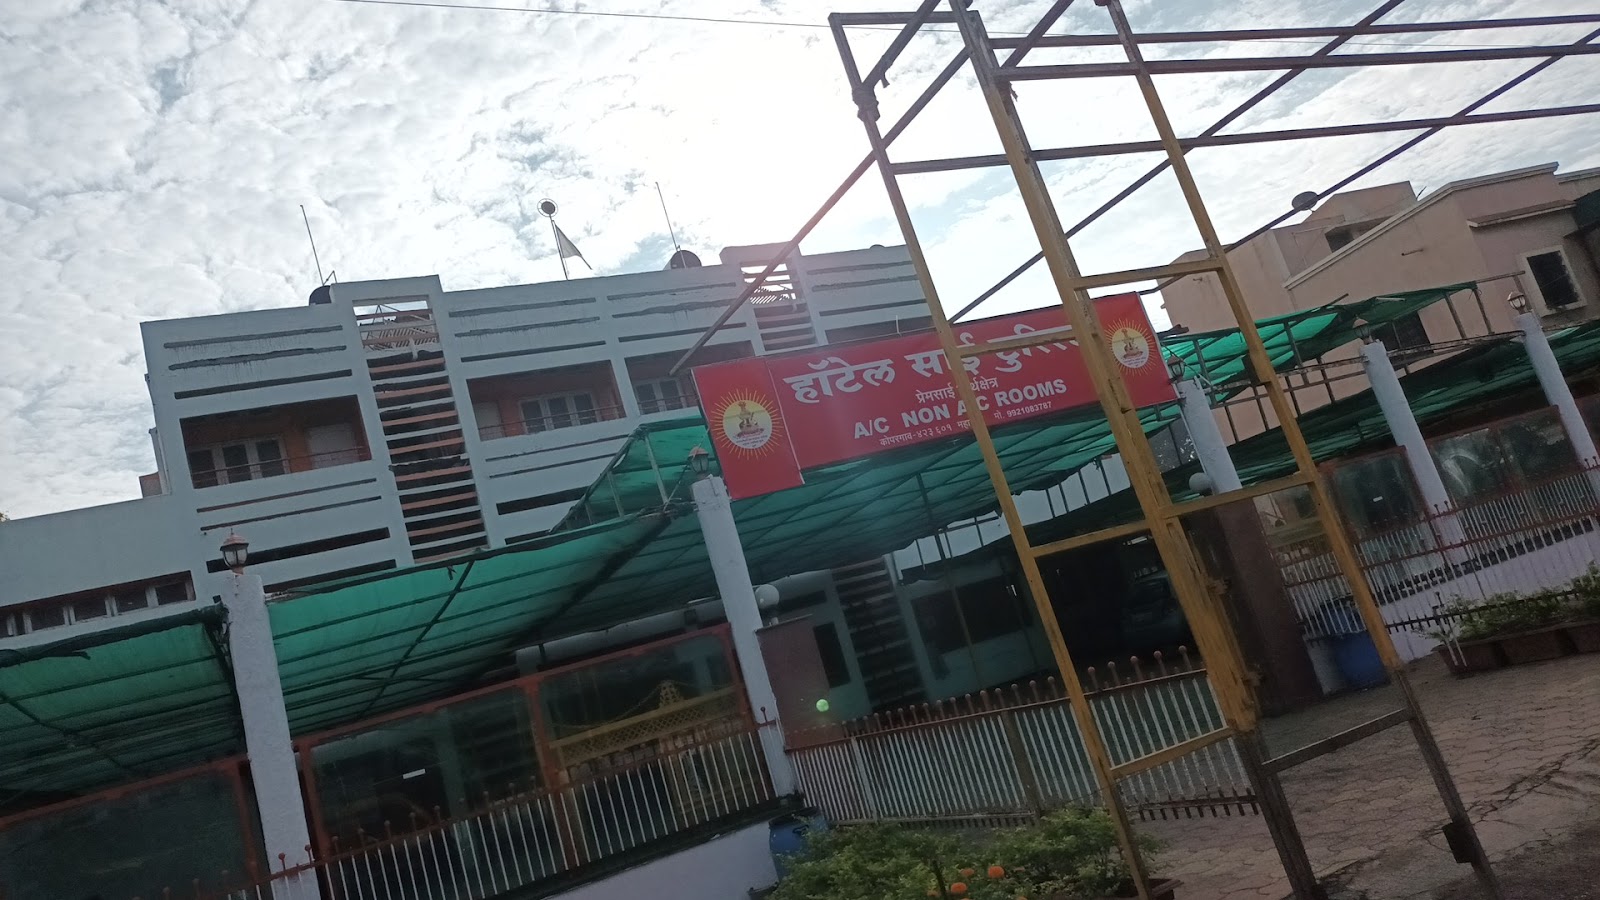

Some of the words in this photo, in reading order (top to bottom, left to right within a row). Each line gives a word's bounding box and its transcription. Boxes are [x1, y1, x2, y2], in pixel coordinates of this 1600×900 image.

[783, 356, 895, 404] हॉटेल
[915, 381, 956, 404] प्रेमसाई
[854, 417, 890, 439] A/C
[901, 403, 951, 428] NON
[957, 395, 990, 417] AC
[994, 378, 1067, 407] ROOMS
[1006, 401, 1053, 418] 9921083787
